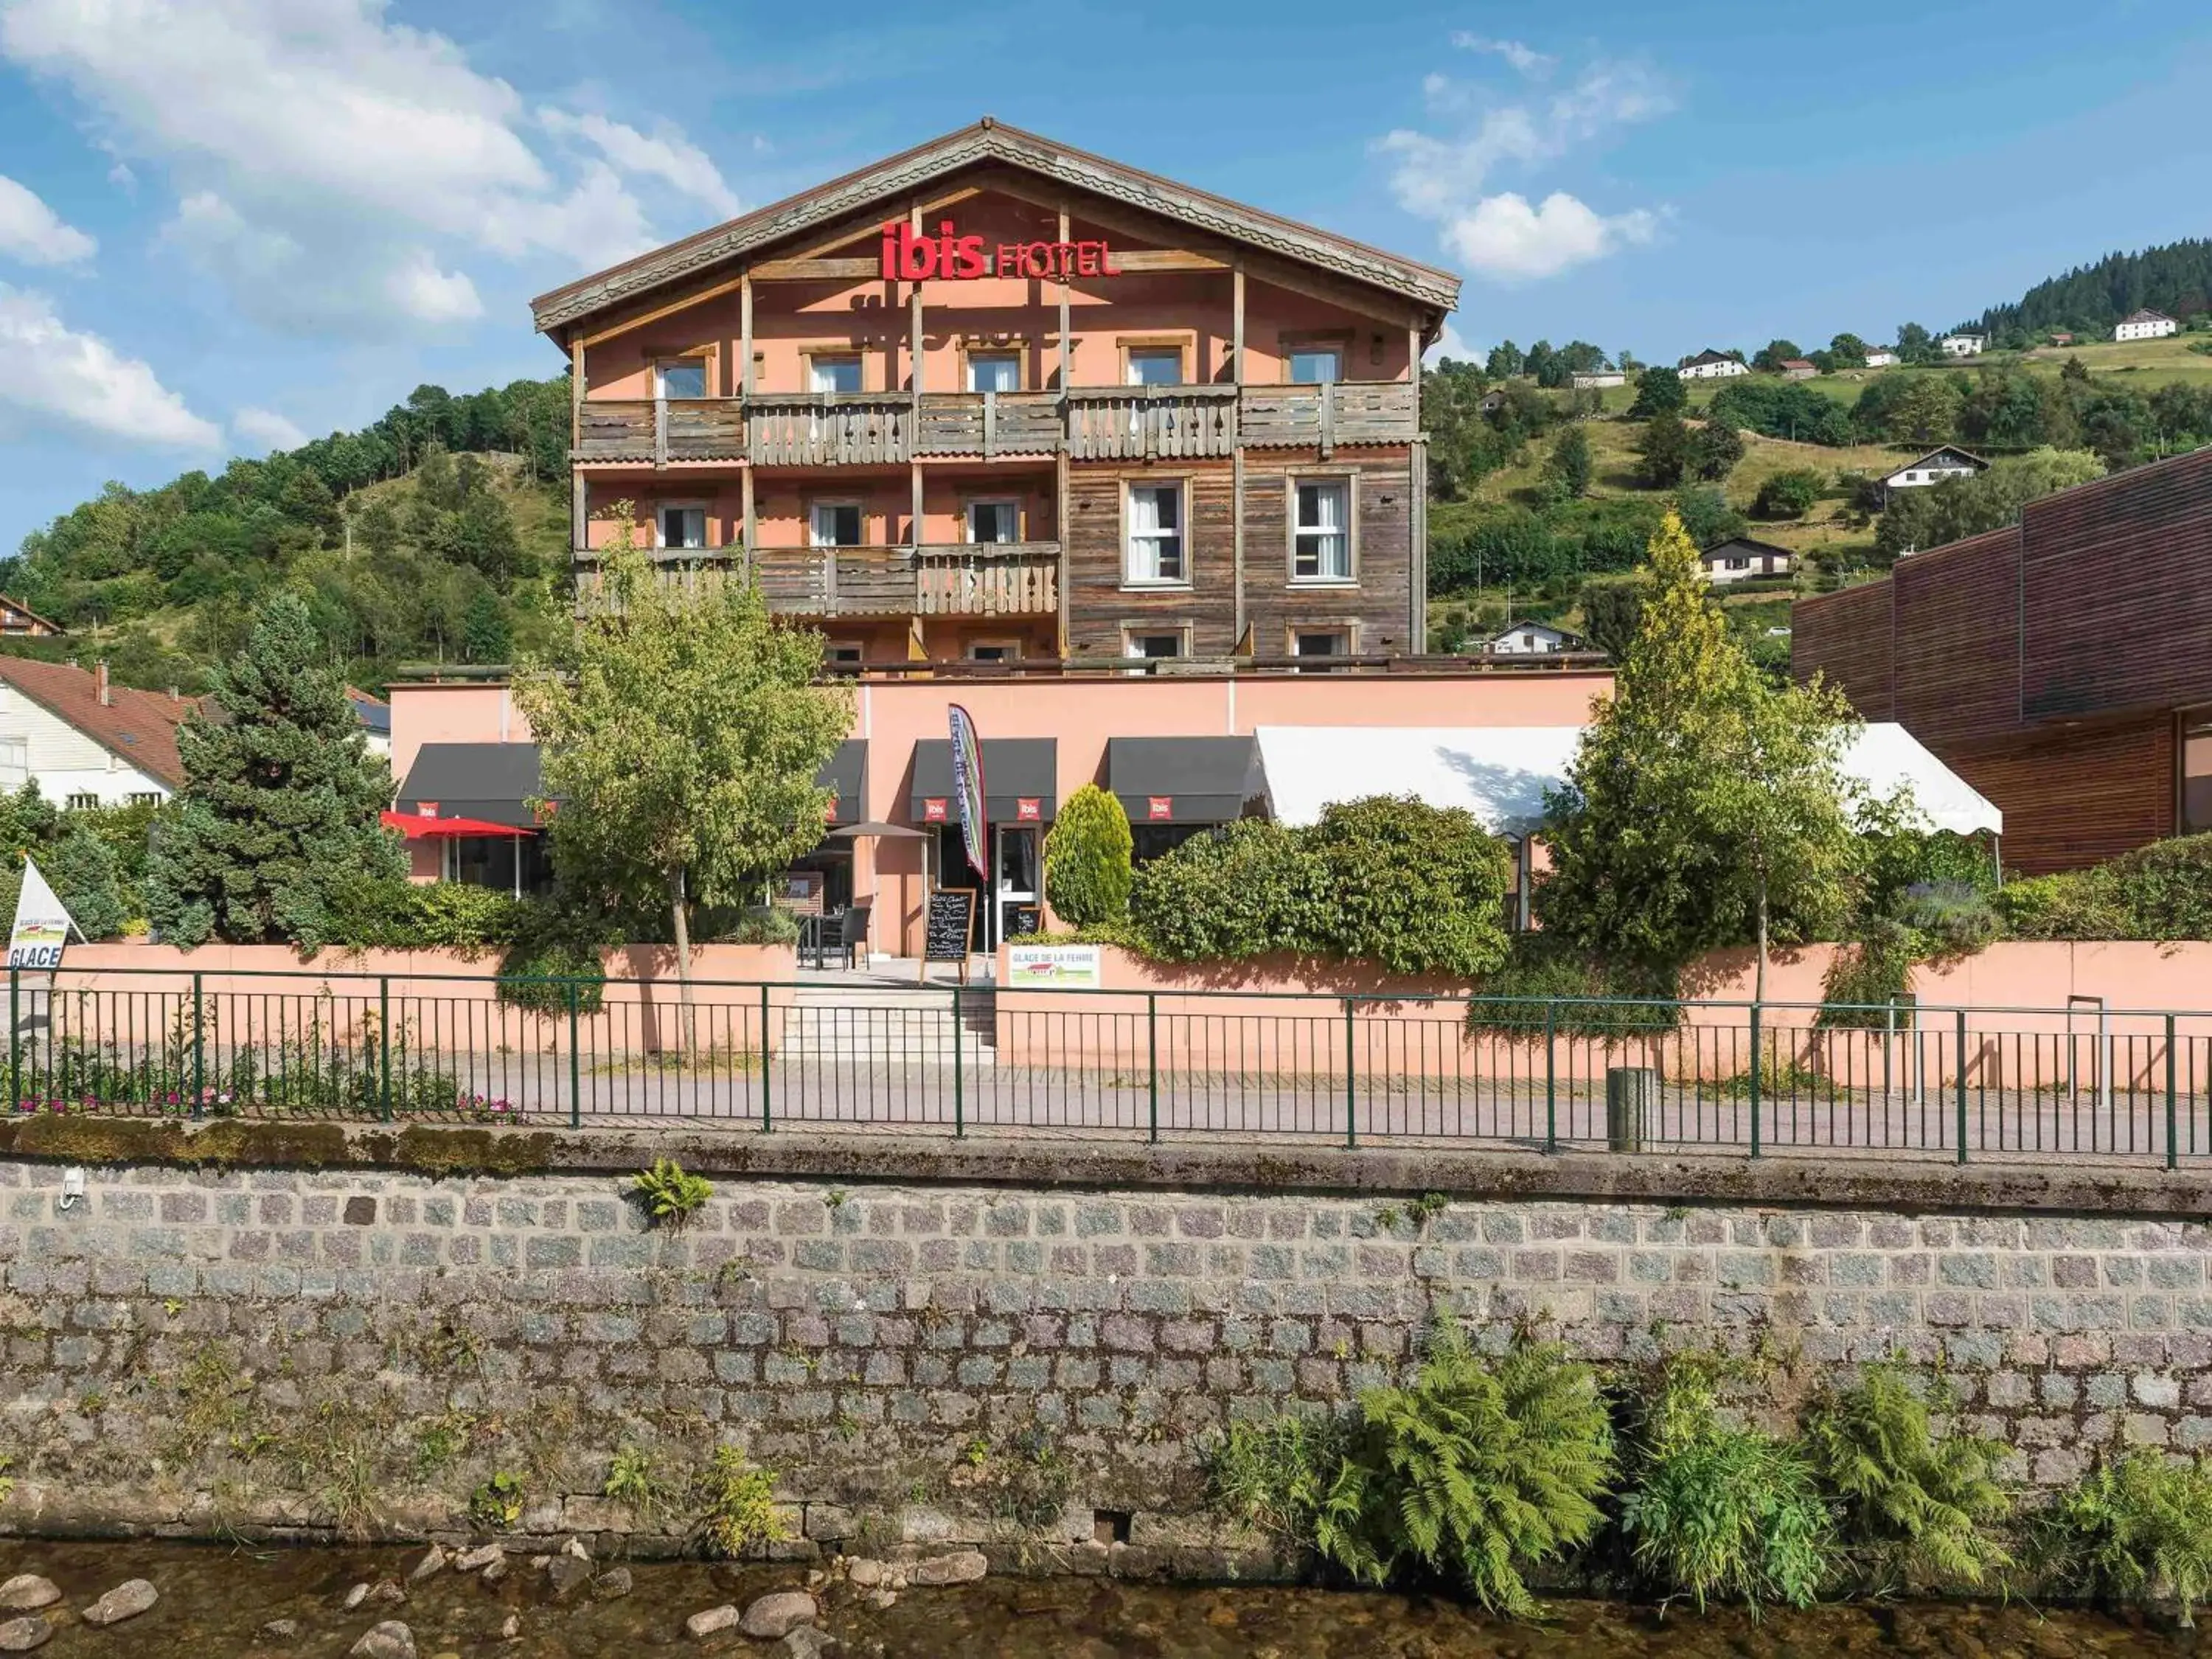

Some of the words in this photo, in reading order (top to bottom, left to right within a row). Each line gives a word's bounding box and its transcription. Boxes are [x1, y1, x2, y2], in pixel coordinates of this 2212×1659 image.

[882, 220, 985, 280] ibis
[998, 240, 1121, 279] HOTEL
[928, 805, 944, 814] ibis
[1021, 804, 1037, 813] ibis
[1152, 803, 1168, 812] ibis
[10, 946, 61, 968] GLACE
